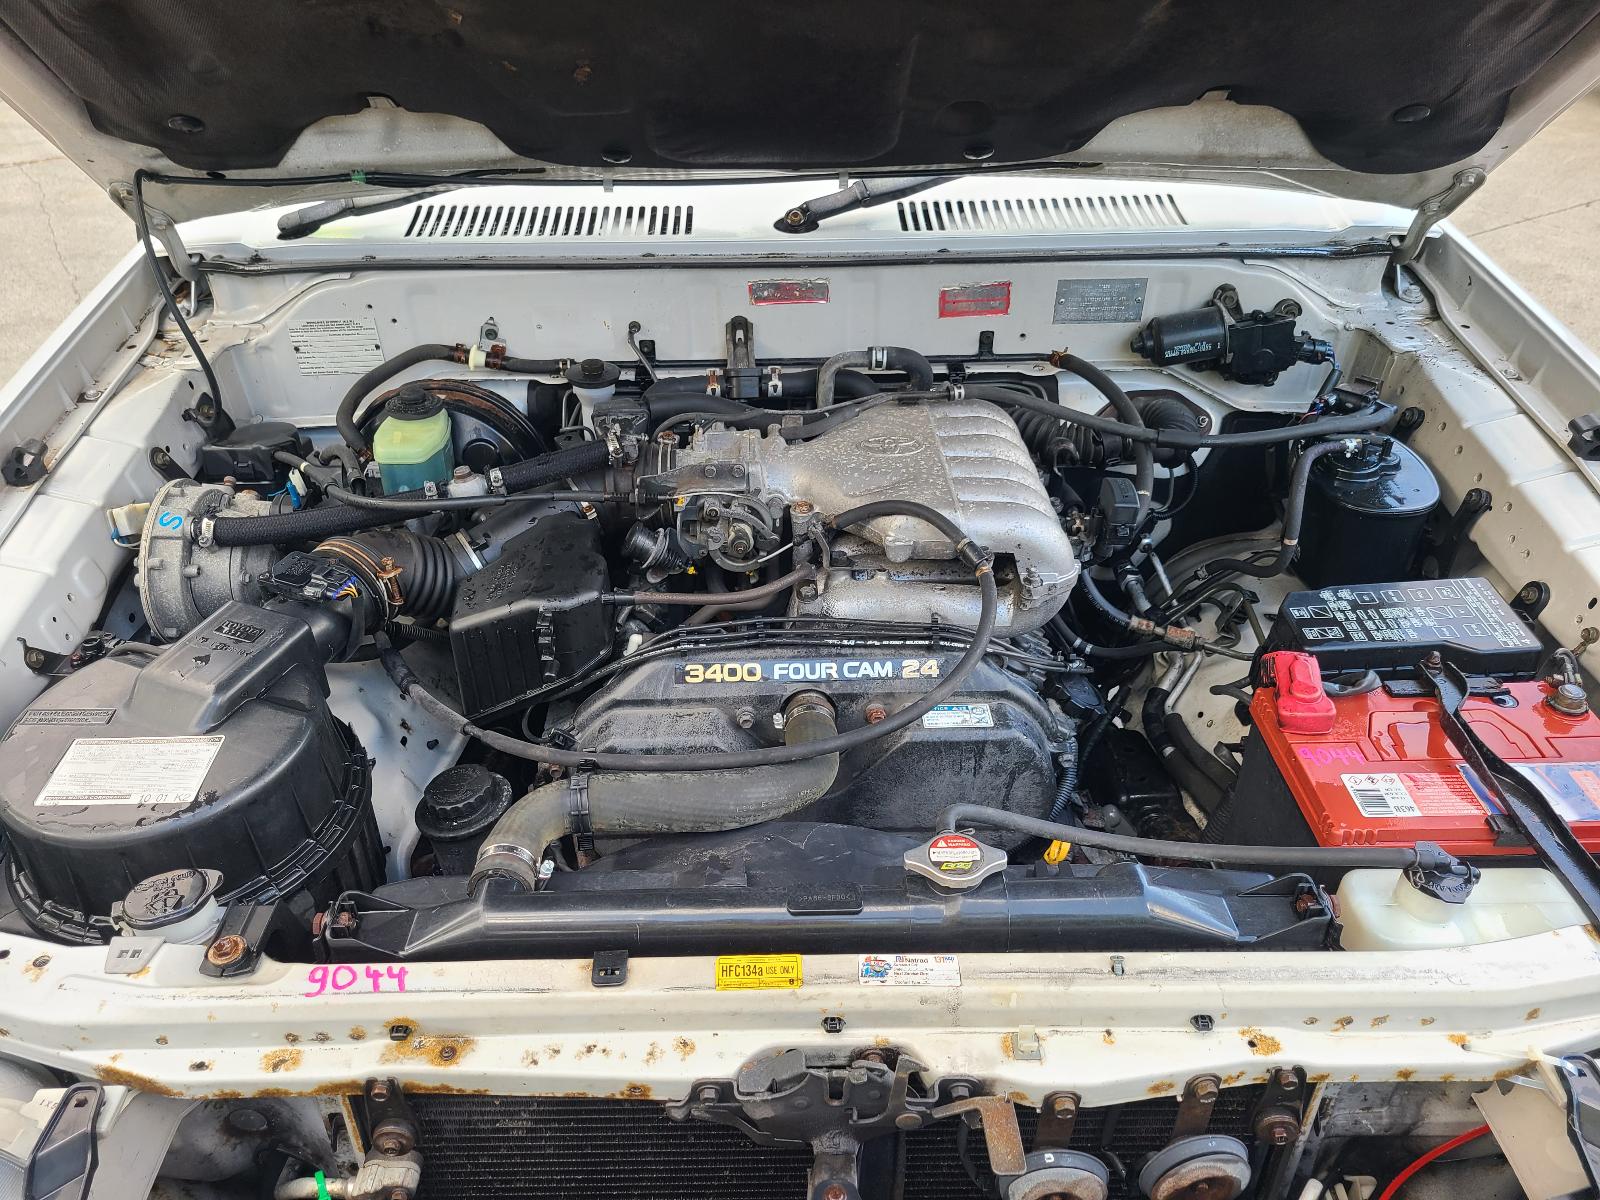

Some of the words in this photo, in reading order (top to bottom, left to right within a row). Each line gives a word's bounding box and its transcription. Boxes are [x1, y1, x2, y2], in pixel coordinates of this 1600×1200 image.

[684, 662, 762, 684] 3400
[773, 662, 839, 681] FOUR
[842, 660, 893, 679] CAM
[901, 658, 940, 679] 24
[304, 965, 409, 998] 9044
[721, 964, 764, 978] HFC134a
[765, 966, 778, 975] USE
[779, 965, 795, 974] ONLY
